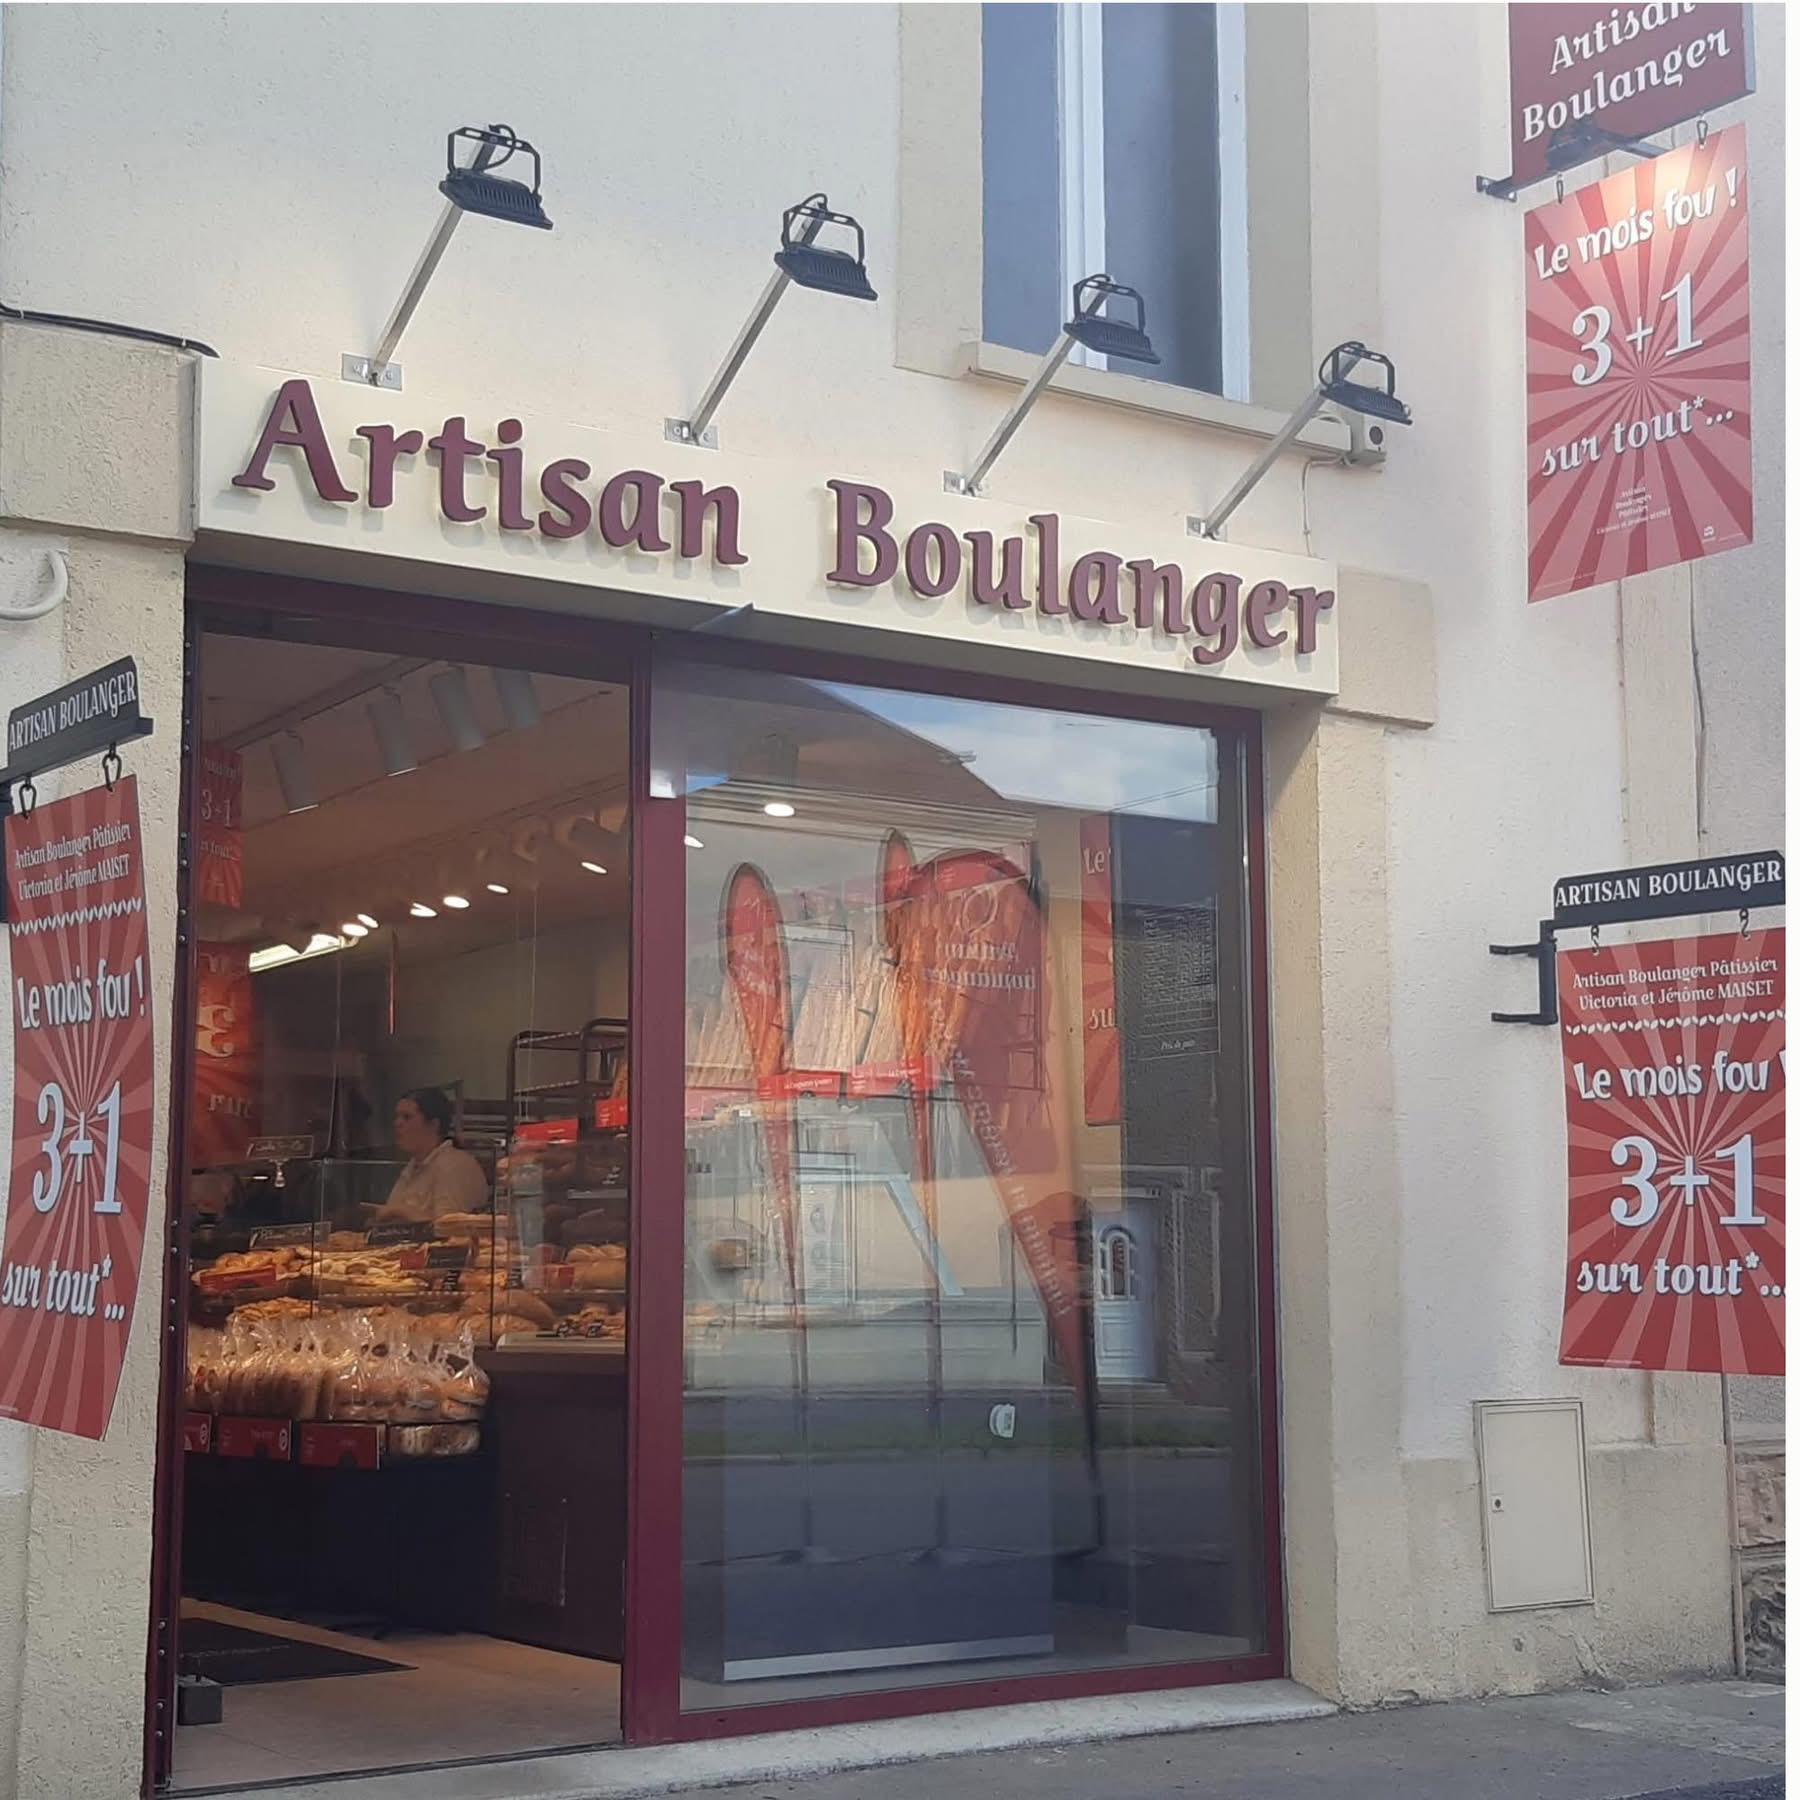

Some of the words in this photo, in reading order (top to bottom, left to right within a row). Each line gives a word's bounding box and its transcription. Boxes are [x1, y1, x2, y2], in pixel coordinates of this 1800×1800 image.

[1522, 28, 1731, 142] Boulanger
[1533, 242, 1570, 280] Le
[1576, 203, 1654, 265] mois
[1661, 184, 1717, 231] fou
[1541, 435, 1601, 477] sur
[231, 378, 749, 566] Artisan
[826, 478, 1335, 665] Boulanger
[8, 706, 57, 752] ARTISAN
[59, 670, 137, 731] BOULANGER
[15, 845, 46, 869] Artisan
[46, 835, 92, 861] Boulanger
[54, 874, 63, 893] et
[1555, 877, 1641, 908] ARTISAN
[1648, 859, 1783, 896] BOULANGER
[16, 976, 40, 1030] Le
[45, 965, 92, 1026] mois
[96, 958, 131, 1019] fou
[1572, 971, 1625, 989] Artisan
[1628, 964, 1706, 985] Boulanger
[1710, 957, 1779, 976] Pâtissier
[1578, 992, 1638, 1011] Victoria
[1640, 990, 1656, 1006] et
[1657, 983, 1715, 1005] Jérôme
[1717, 979, 1775, 999] MAISET
[1572, 1060, 1612, 1100] Le
[1619, 1055, 1703, 1097] mois
[1711, 1050, 1769, 1092] fou
[1, 1260, 41, 1309] sur
[1575, 1260, 1643, 1294] sur
